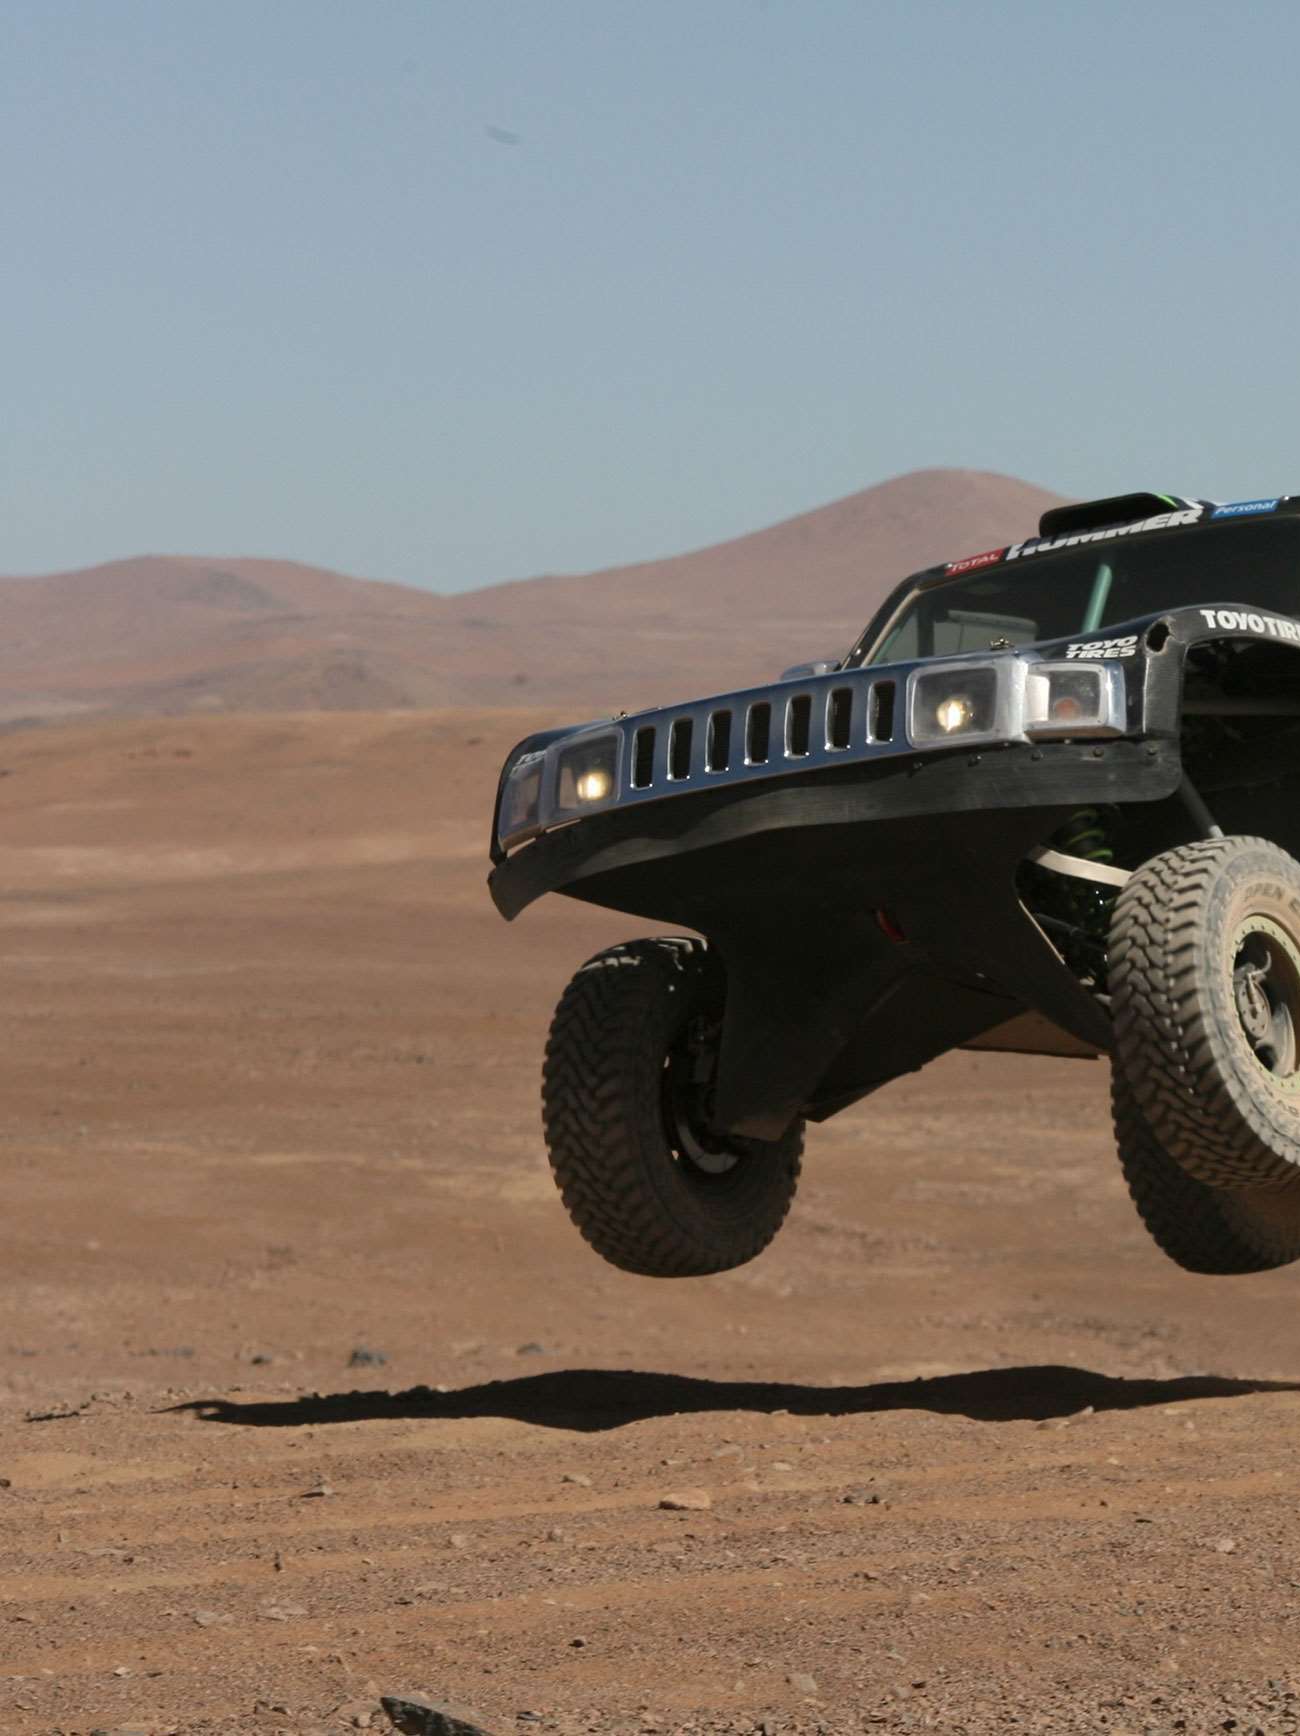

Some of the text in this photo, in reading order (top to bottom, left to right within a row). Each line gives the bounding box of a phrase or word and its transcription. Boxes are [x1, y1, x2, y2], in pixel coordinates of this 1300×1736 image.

[1214, 500, 1277, 515] Personal
[1005, 508, 1204, 561] HUMMER
[951, 553, 1000, 573] TOTAL
[1199, 609, 1264, 634] TOYO
[1067, 635, 1138, 650] TOYO
[1065, 645, 1136, 659] TIRES
